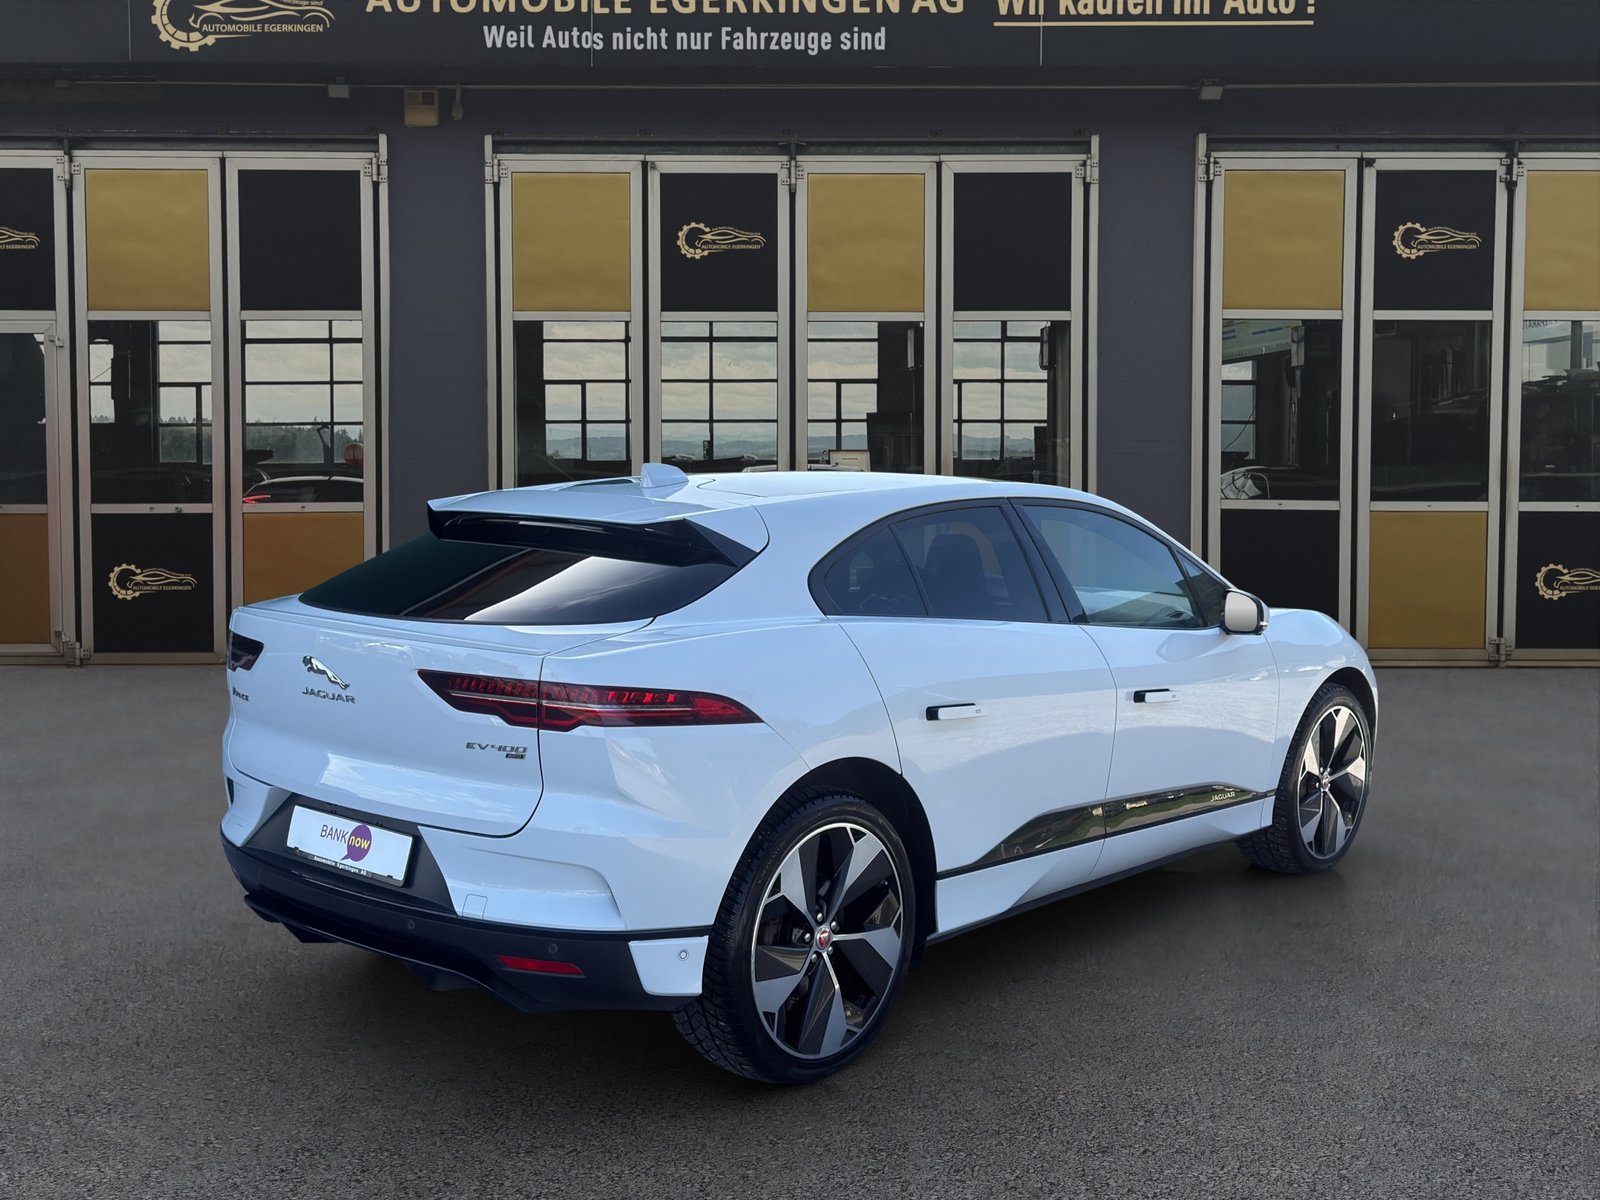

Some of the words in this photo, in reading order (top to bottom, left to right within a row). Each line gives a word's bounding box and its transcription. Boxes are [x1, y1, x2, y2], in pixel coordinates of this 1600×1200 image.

[911, 0, 964, 14] AG
[201, 23, 263, 33] AUTOMOBILE
[264, 23, 324, 33] EGERKINGEN
[482, 25, 534, 49] Weil
[542, 25, 604, 50] Autos
[612, 26, 668, 51] nicht
[676, 31, 713, 51] nur
[721, 26, 832, 56] Fahrzeuge
[840, 26, 886, 51] sind
[301, 686, 357, 705] JAGUAR
[465, 742, 528, 754] EV400
[1210, 791, 1236, 802] JAGUAR
[319, 824, 349, 845] BANK
[349, 835, 371, 850] now
[313, 855, 335, 867] Automobile
[336, 862, 359, 873] Egerkingen
